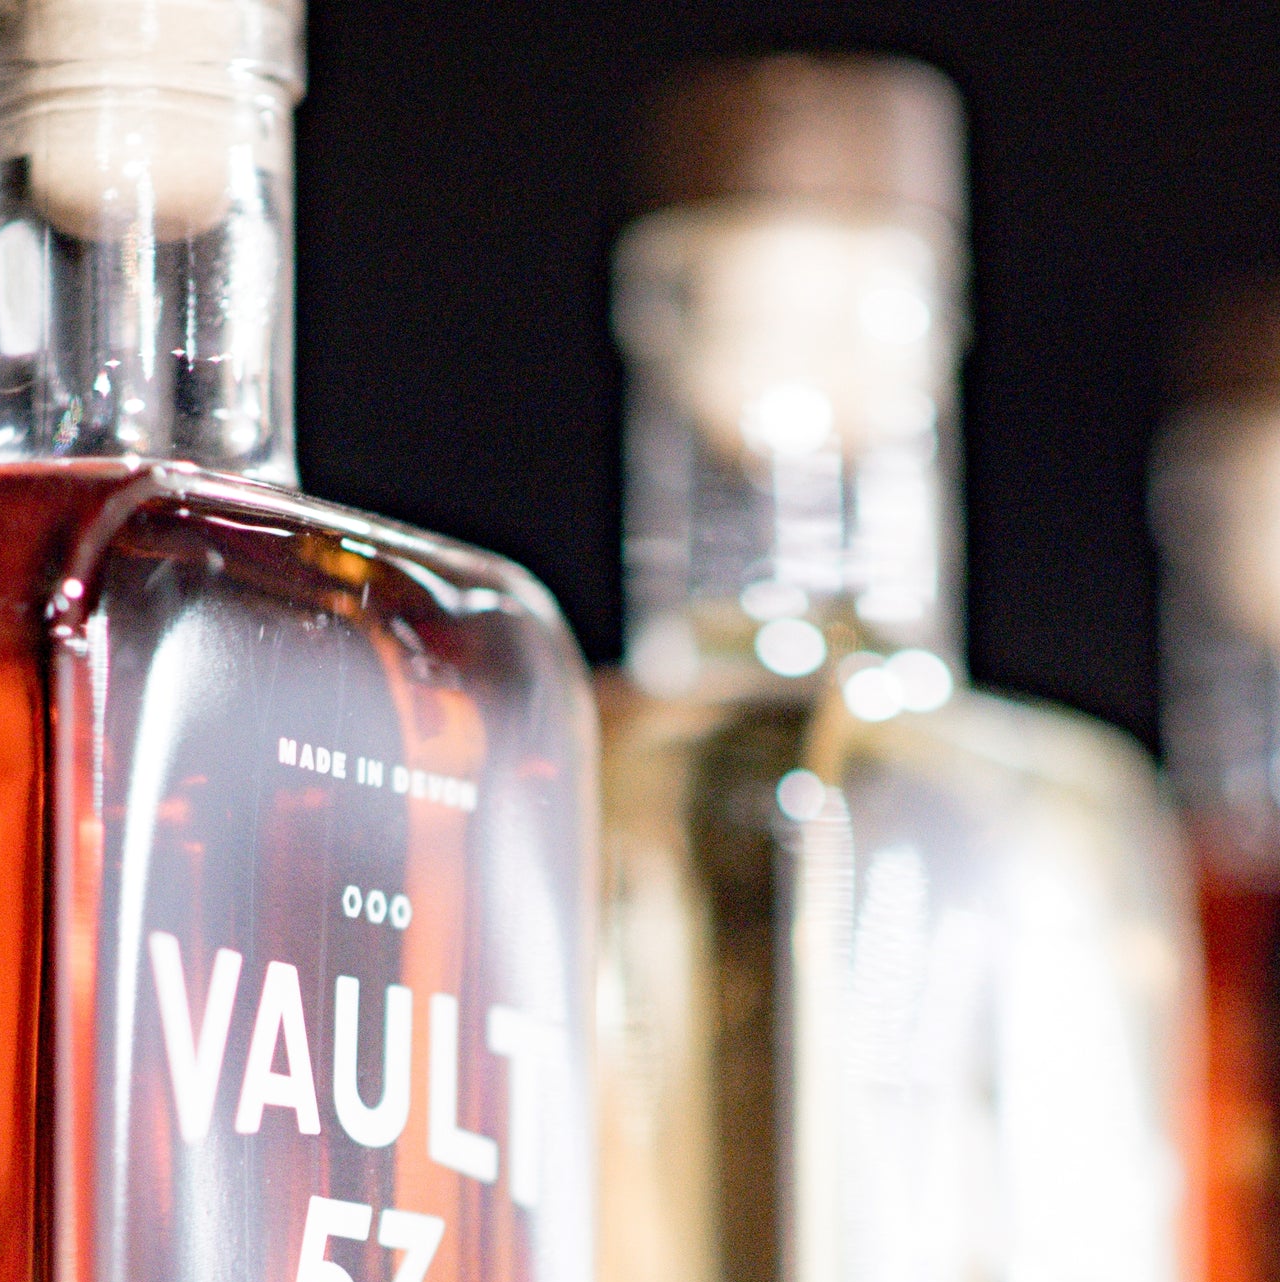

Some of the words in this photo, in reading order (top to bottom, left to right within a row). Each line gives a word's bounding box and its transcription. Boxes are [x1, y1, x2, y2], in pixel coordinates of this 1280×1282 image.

[278, 736, 347, 780] MADE
[357, 756, 384, 788] IN
[392, 765, 479, 814] DEVON
[150, 930, 568, 1209] VAULT
